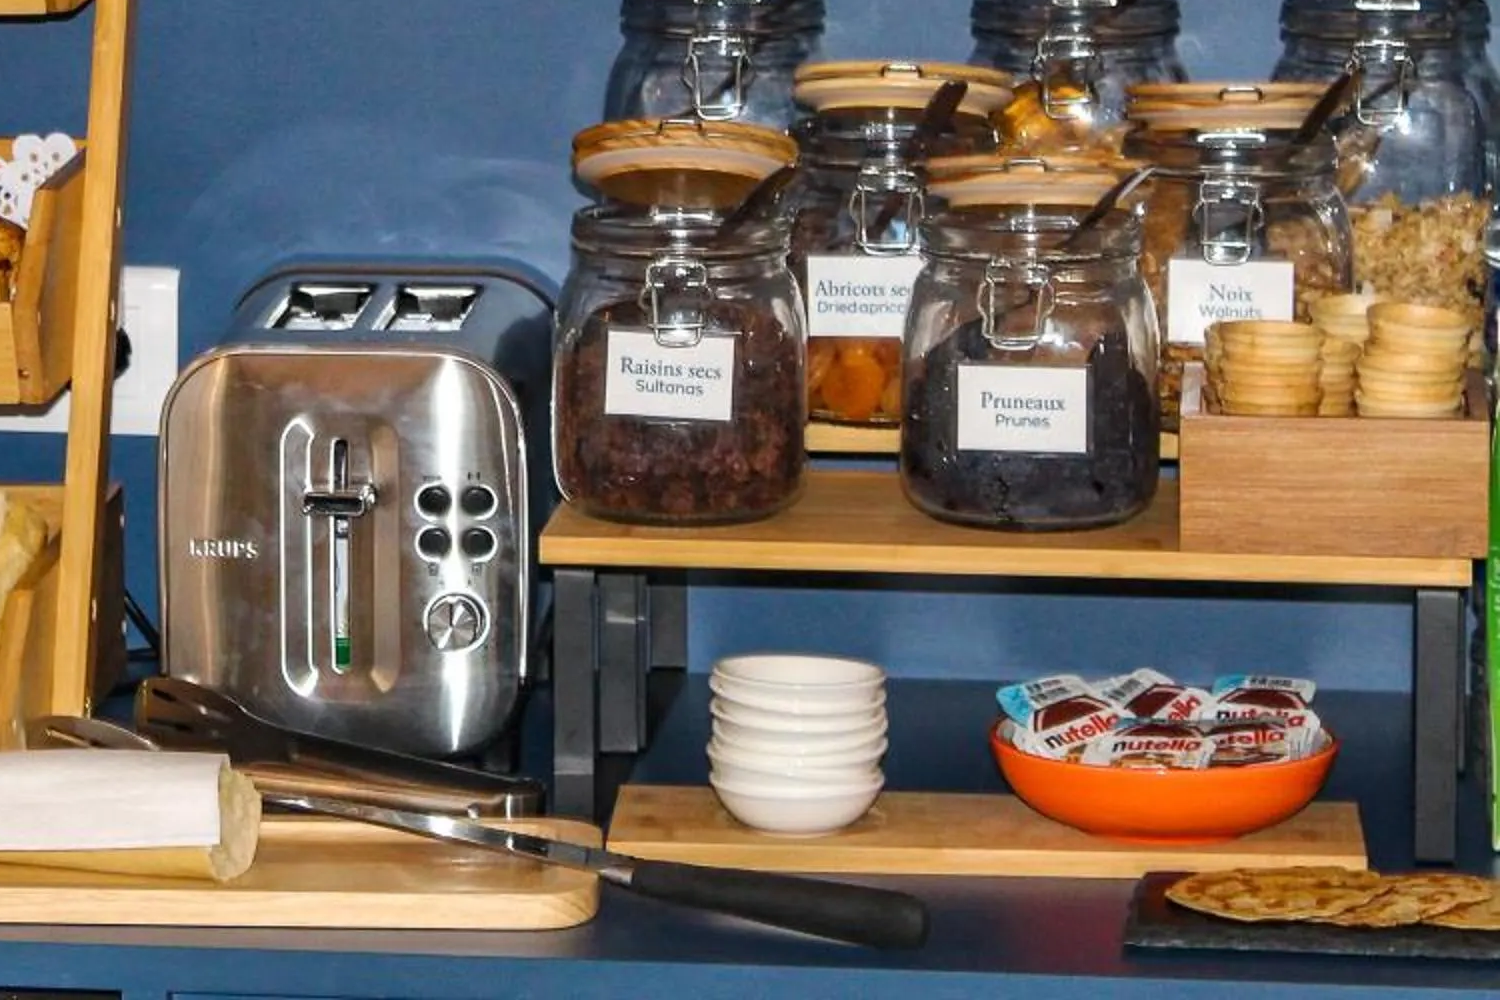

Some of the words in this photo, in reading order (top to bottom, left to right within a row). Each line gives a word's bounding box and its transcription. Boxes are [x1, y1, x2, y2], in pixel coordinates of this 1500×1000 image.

[815, 279, 885, 297] Abricots
[1207, 283, 1254, 301] Noix
[817, 300, 857, 314] Dried
[1198, 303, 1263, 318] Walnuts
[620, 356, 683, 377] Raisins
[688, 365, 722, 380] secs
[635, 379, 704, 396] Sultanas
[980, 391, 1066, 411] Pruneaux
[995, 413, 1051, 430] Prunes
[188, 538, 259, 559] KRUPS
[1044, 713, 1120, 750] nutella
[1111, 739, 1202, 753] nutella
